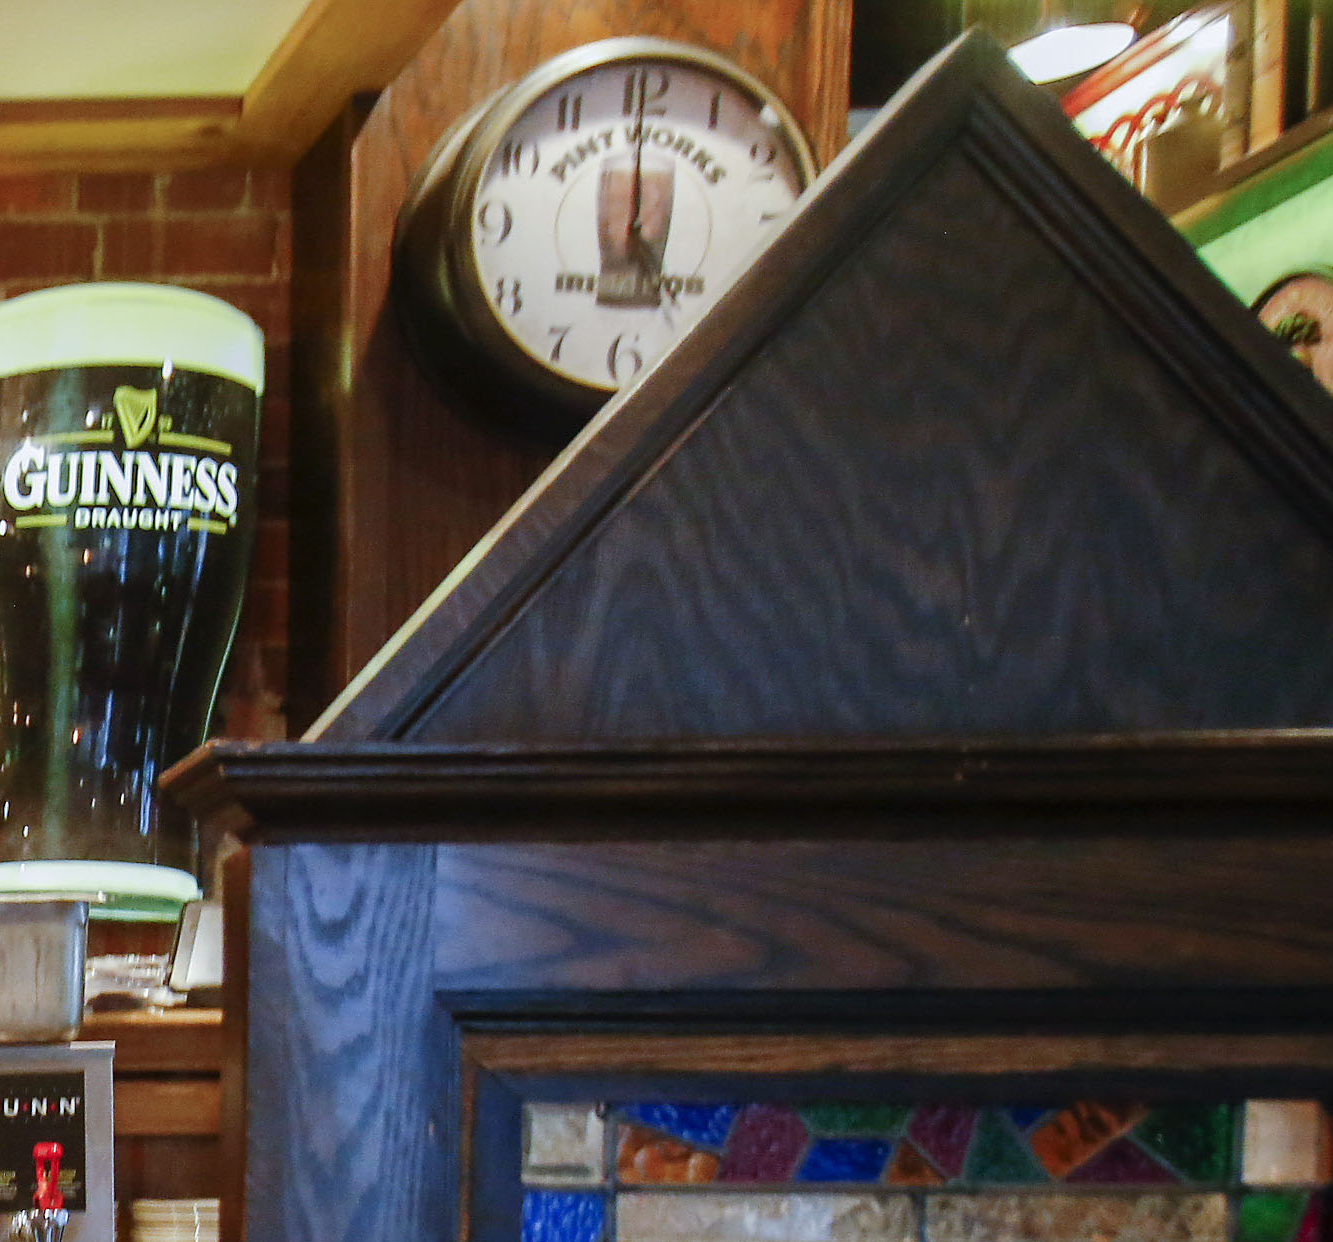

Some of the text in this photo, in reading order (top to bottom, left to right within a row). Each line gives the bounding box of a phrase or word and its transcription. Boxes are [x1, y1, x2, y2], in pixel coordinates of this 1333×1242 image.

[550, 127, 727, 185] PINT WORKS
[3, 436, 239, 519] GUINNESS
[74, 507, 183, 533] DRAUGHT
